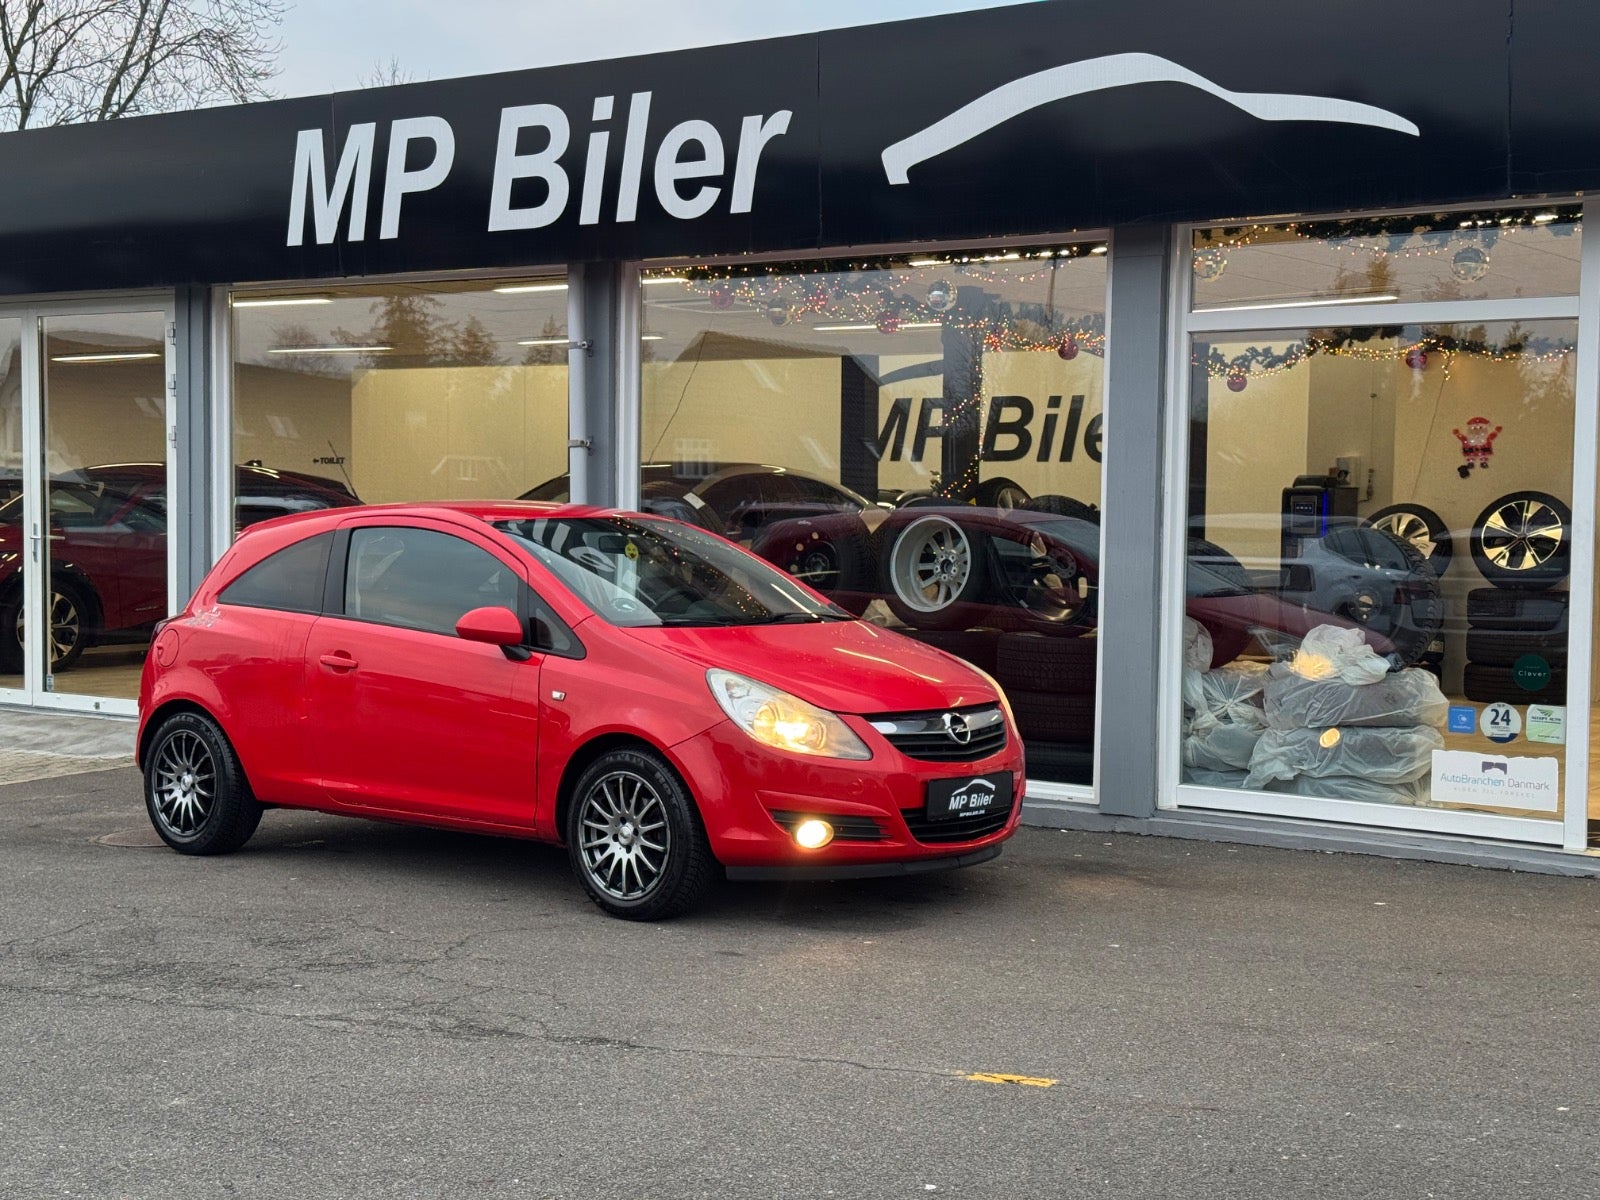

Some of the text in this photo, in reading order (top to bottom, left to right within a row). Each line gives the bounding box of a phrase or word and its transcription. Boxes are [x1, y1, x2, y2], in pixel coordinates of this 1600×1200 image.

[287, 91, 793, 247] MP Biler
[1490, 708, 1511, 726] 24
[1440, 773, 1550, 791] AutoBranchen Danmark
[948, 793, 994, 810] MP Biler
